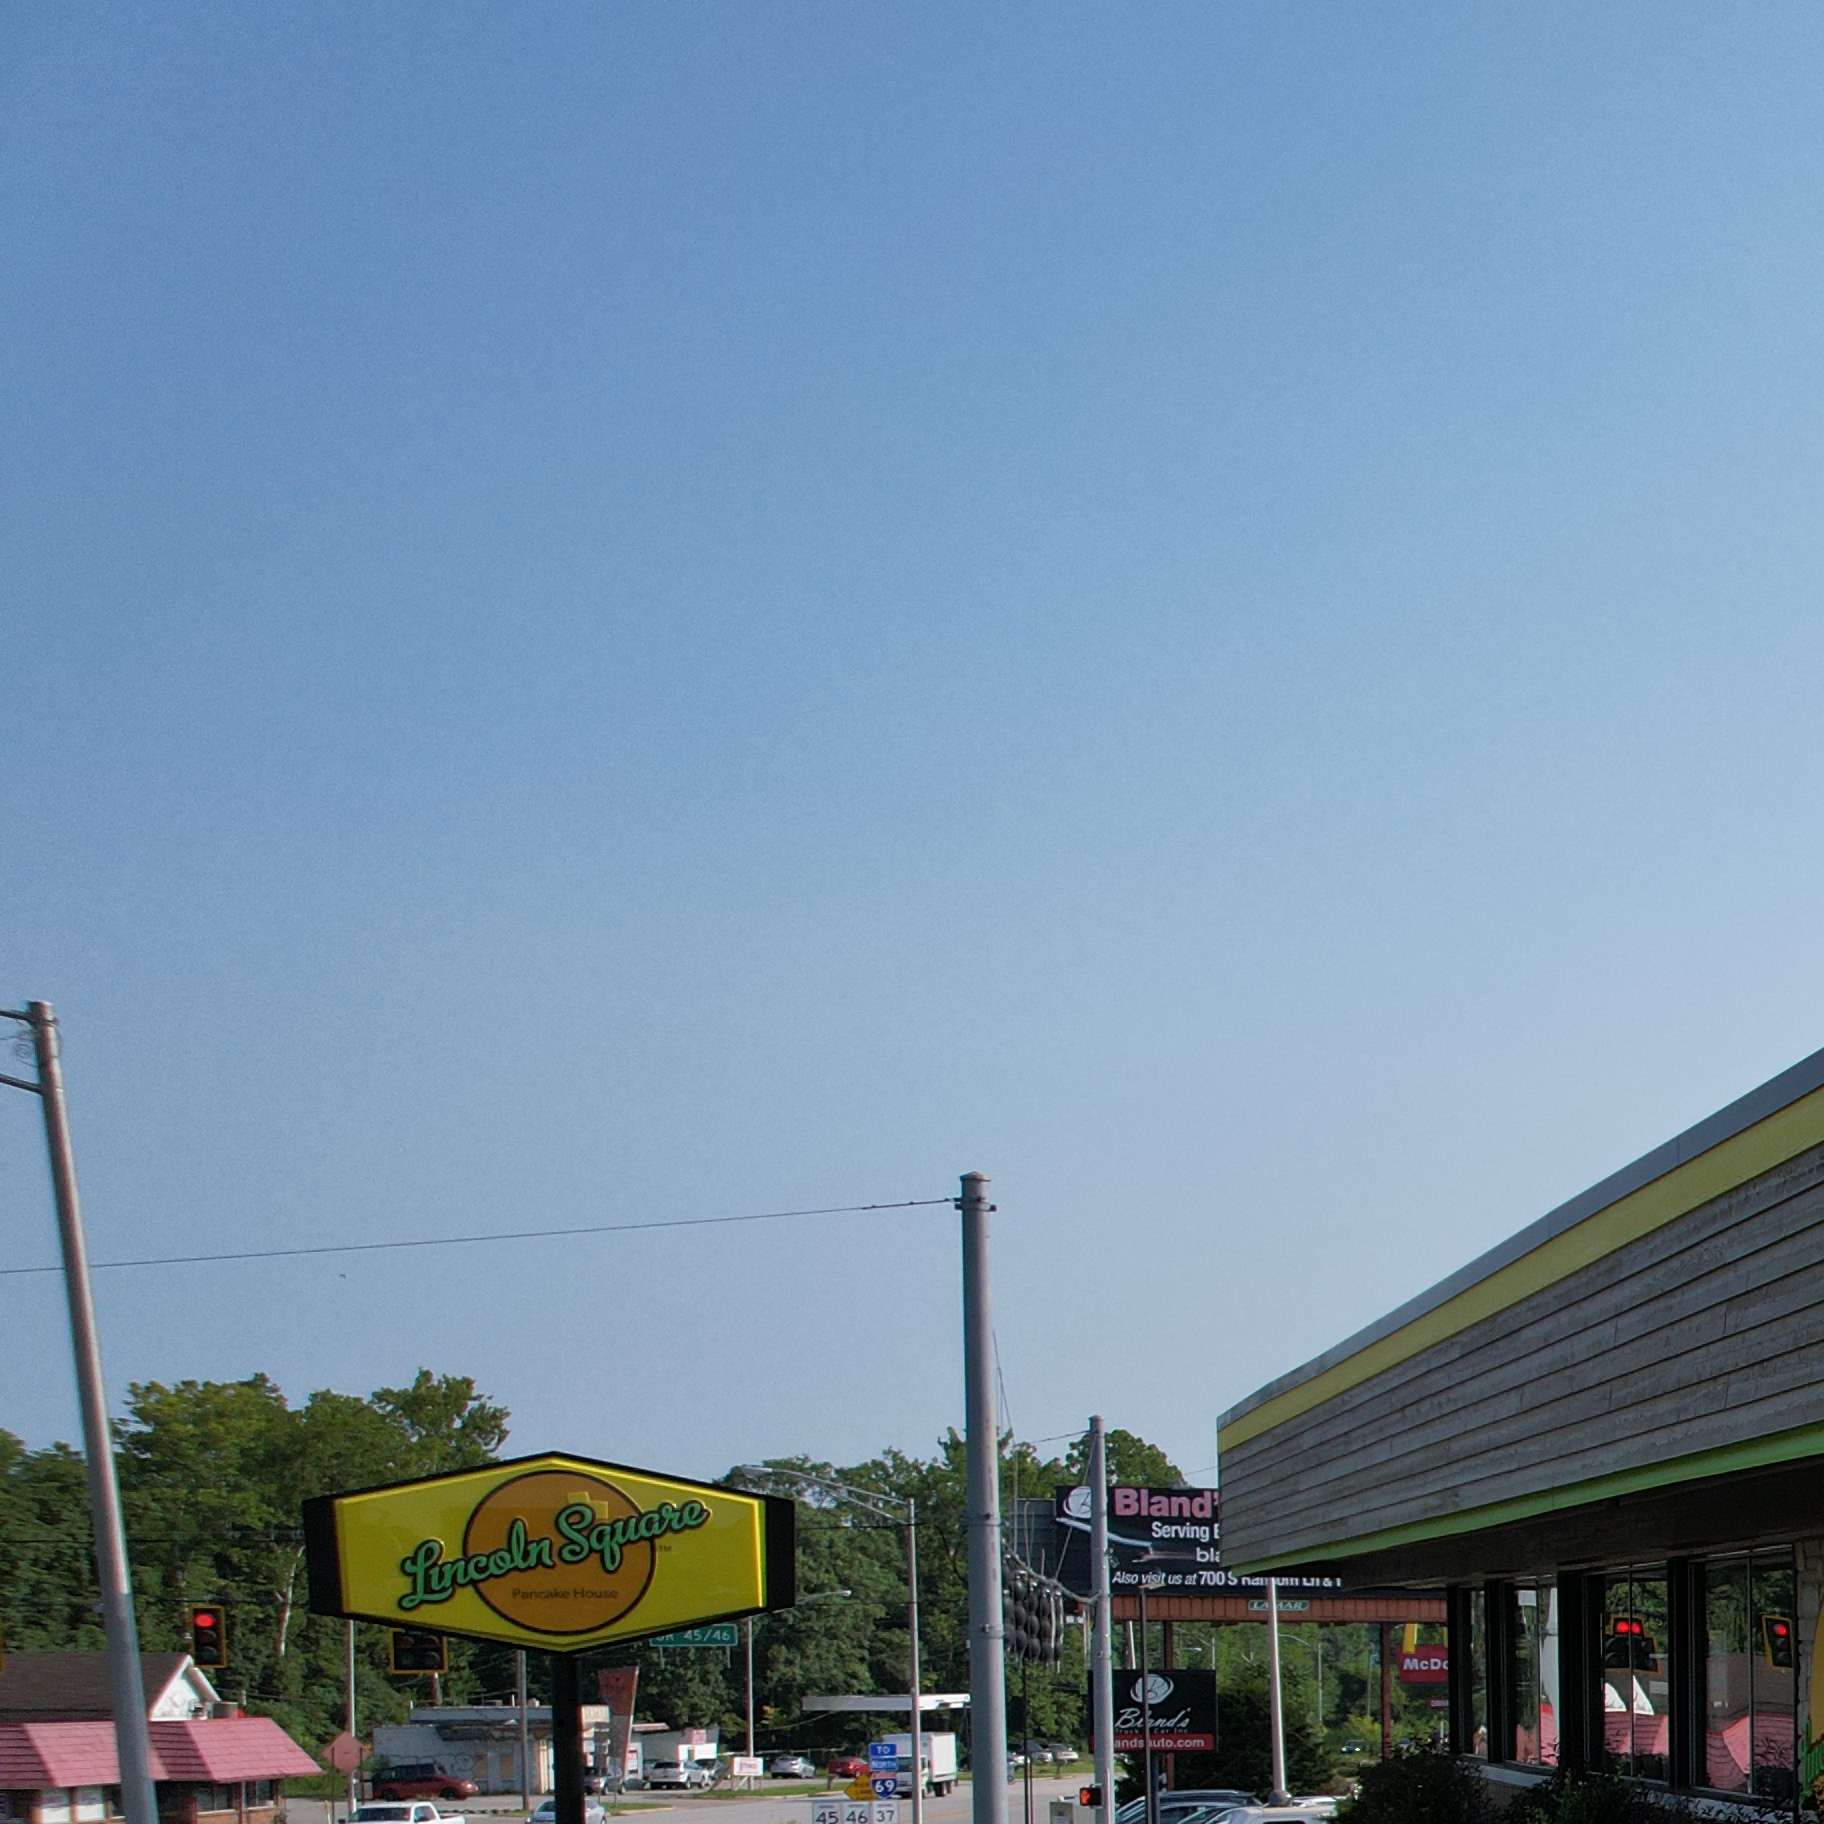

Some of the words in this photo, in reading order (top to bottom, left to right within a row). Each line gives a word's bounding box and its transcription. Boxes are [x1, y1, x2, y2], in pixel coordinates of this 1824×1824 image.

[1151, 1521, 1211, 1542] Serving
[398, 1516, 555, 1610] Lincoln
[556, 1499, 712, 1574] Square
[1112, 1570, 1139, 1585] Also
[1141, 1570, 1166, 1585] visit
[1167, 1574, 1182, 1585] us
[1184, 1572, 1198, 1585] at
[1199, 1570, 1226, 1586] 700
[511, 1587, 570, 1600] Pancake
[573, 1586, 619, 1600] House
[683, 1629, 731, 1642] 45/46
[875, 1745, 891, 1755] TO
[871, 1760, 897, 1769] NORTH
[874, 1779, 896, 1793] 69
[845, 1811, 868, 1824] 46
[876, 1810, 895, 1823] 37
